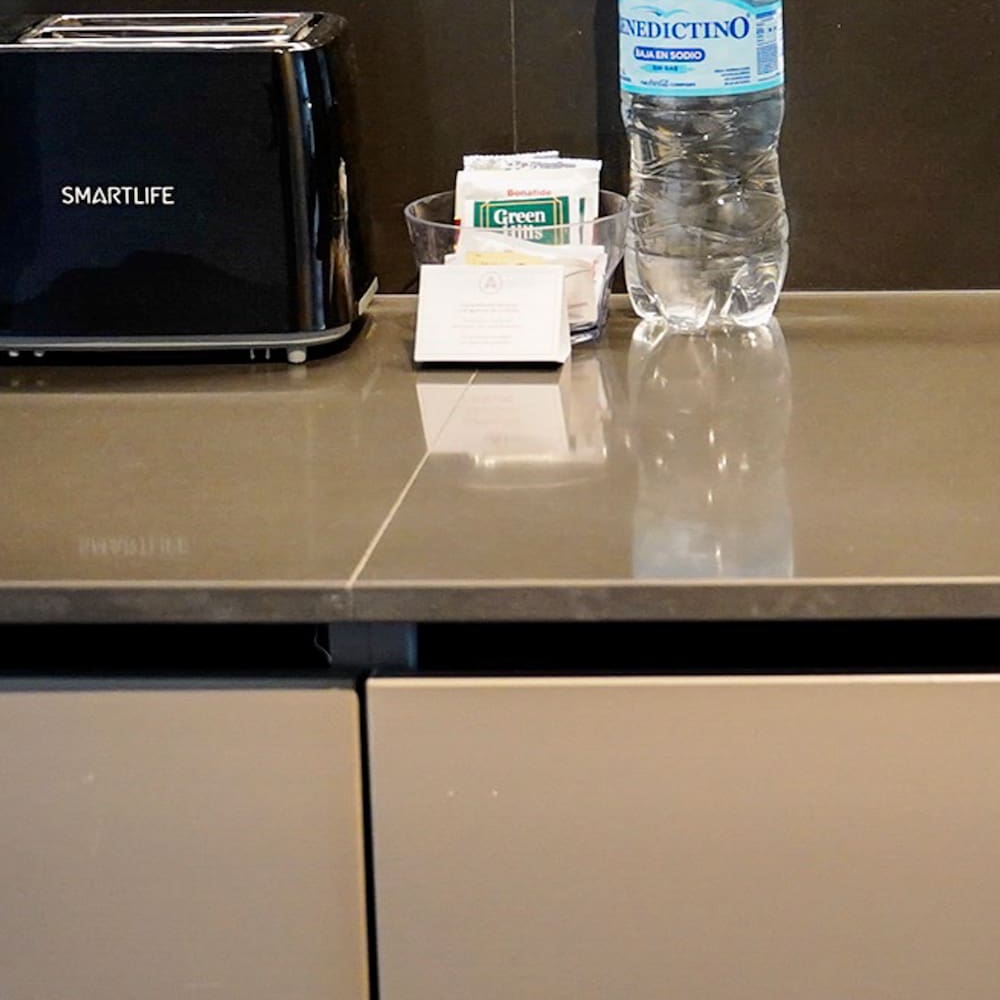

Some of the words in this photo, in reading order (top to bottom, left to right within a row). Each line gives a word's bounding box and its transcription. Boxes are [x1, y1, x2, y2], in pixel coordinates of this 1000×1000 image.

[619, 16, 750, 39] ENEDICTINO
[656, 51, 668, 59] EN
[670, 51, 702, 60] SODIO
[61, 186, 175, 205] SMARTLIFE
[494, 208, 546, 225] Green
